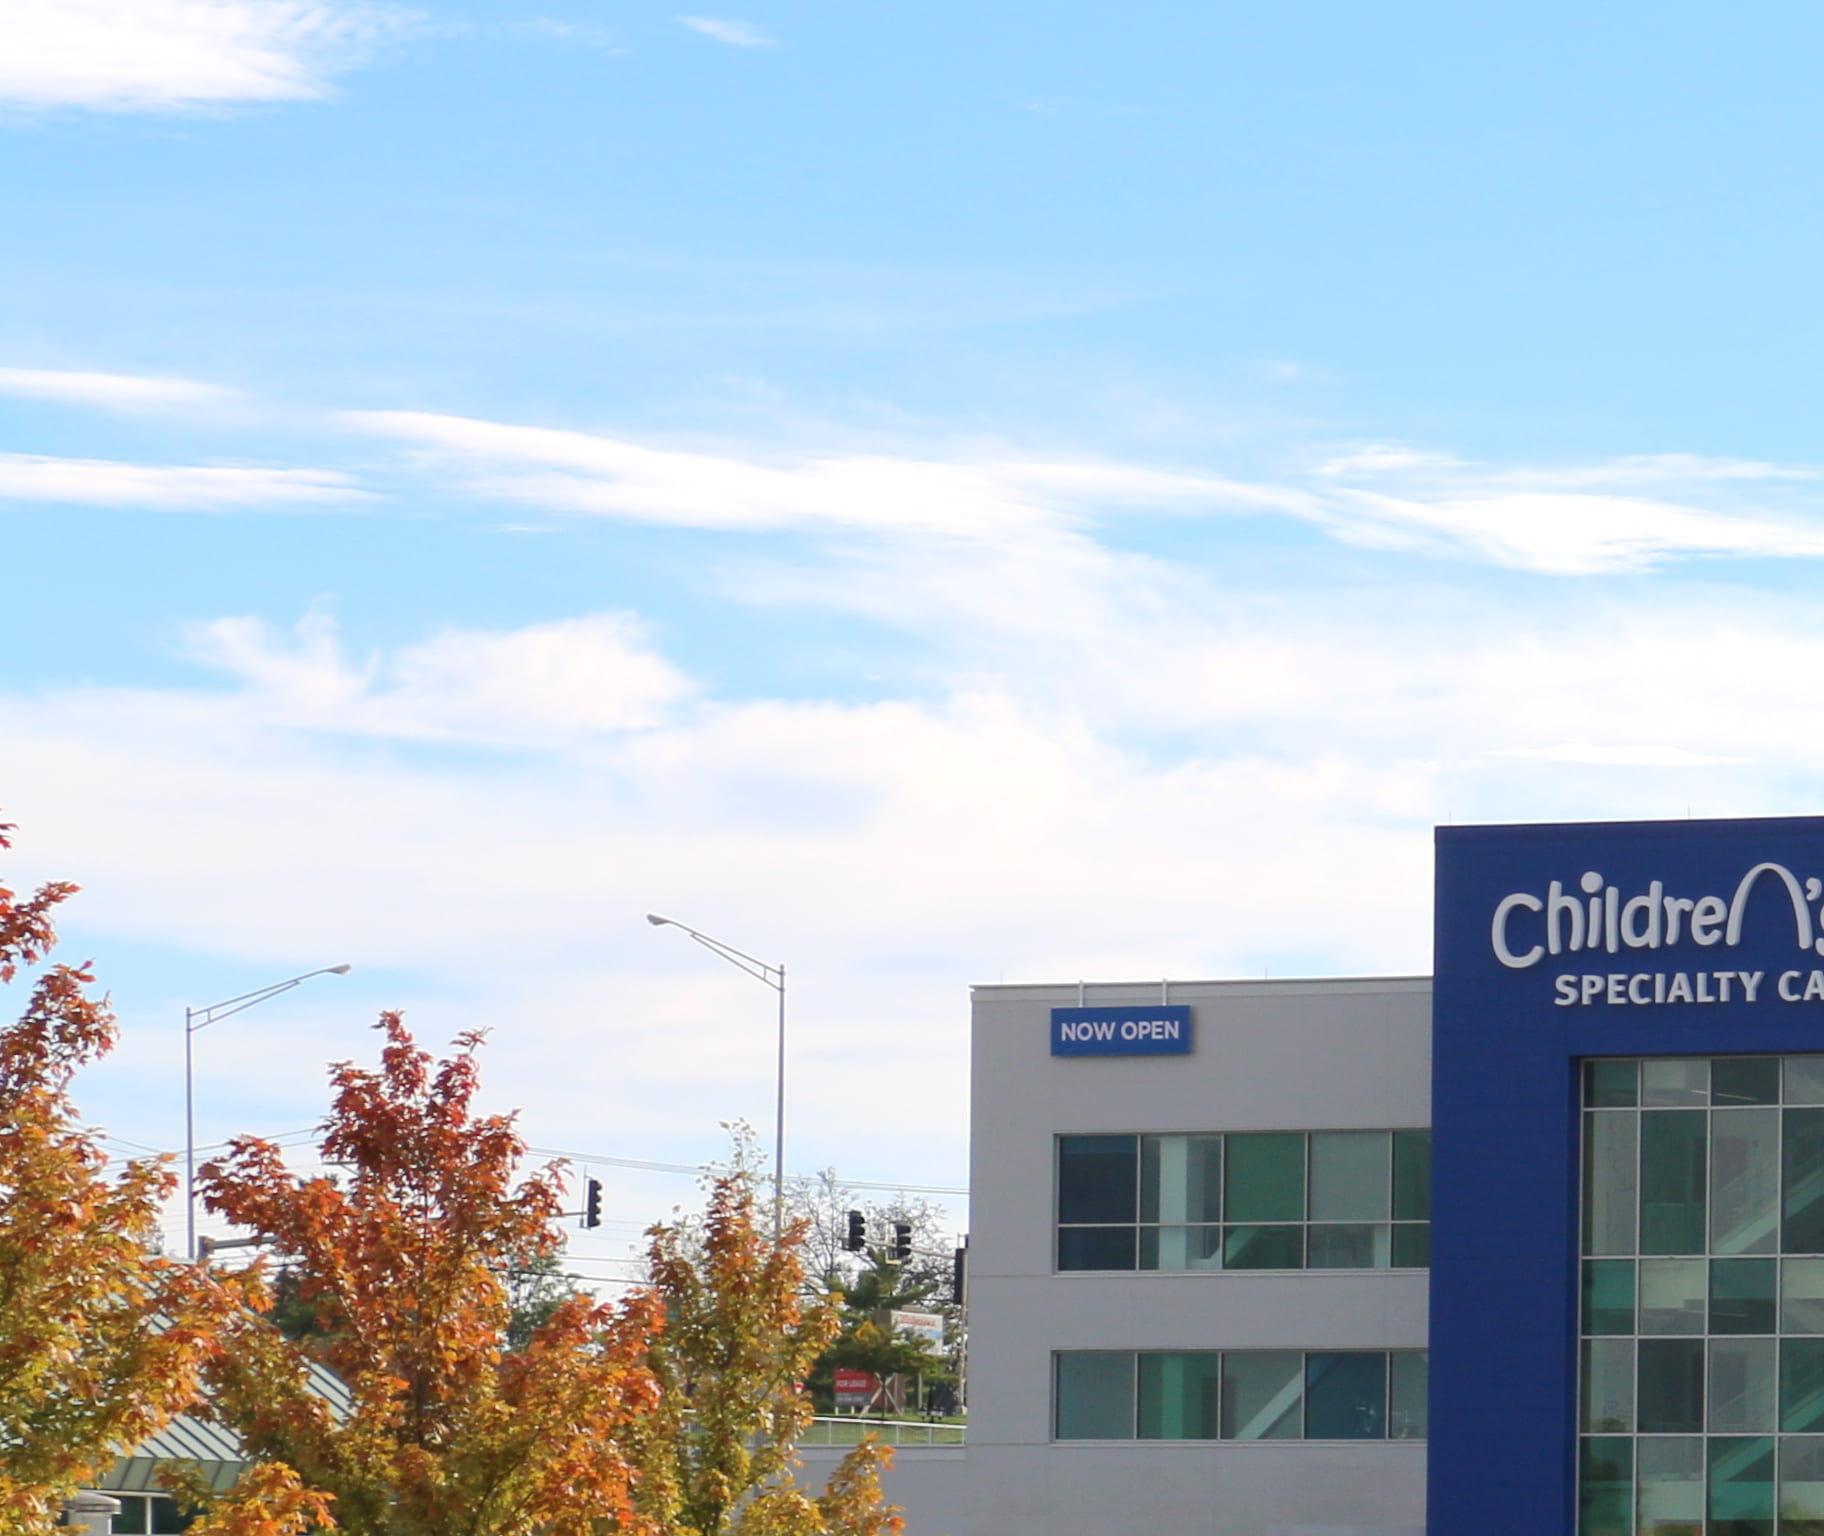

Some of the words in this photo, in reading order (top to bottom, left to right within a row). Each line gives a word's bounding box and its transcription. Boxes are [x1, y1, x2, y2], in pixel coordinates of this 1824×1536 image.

[1554, 971, 1765, 1006] SPECIALTY
[1061, 1021, 1116, 1041] NOW
[1120, 1020, 1180, 1040] OPEN
